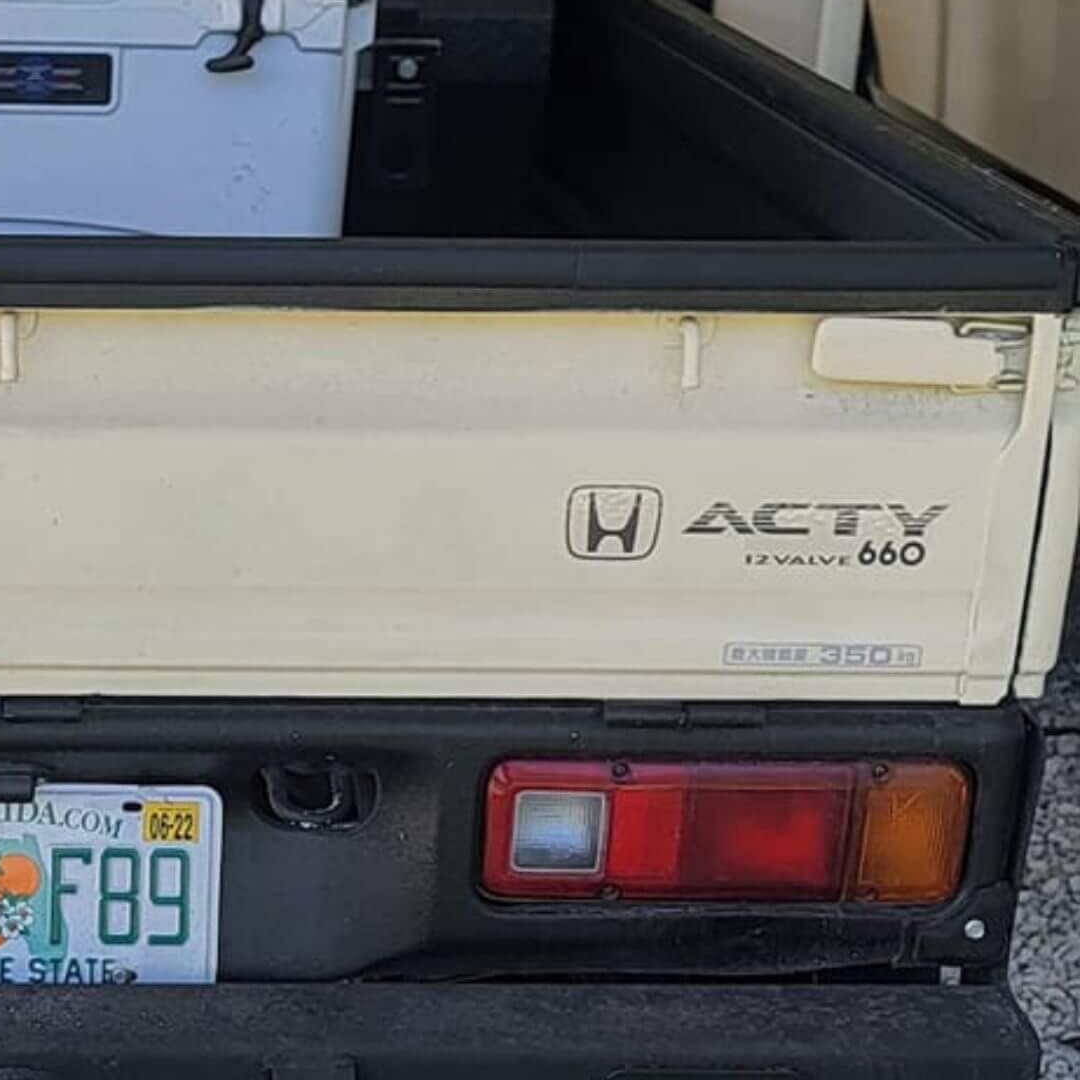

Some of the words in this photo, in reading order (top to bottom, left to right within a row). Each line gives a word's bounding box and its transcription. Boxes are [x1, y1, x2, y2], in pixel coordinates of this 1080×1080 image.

[682, 502, 950, 537] ACTY
[857, 541, 926, 566] 660
[821, 644, 892, 664] 350
[149, 812, 193, 841] 06-22
[49, 848, 190, 946] F89
